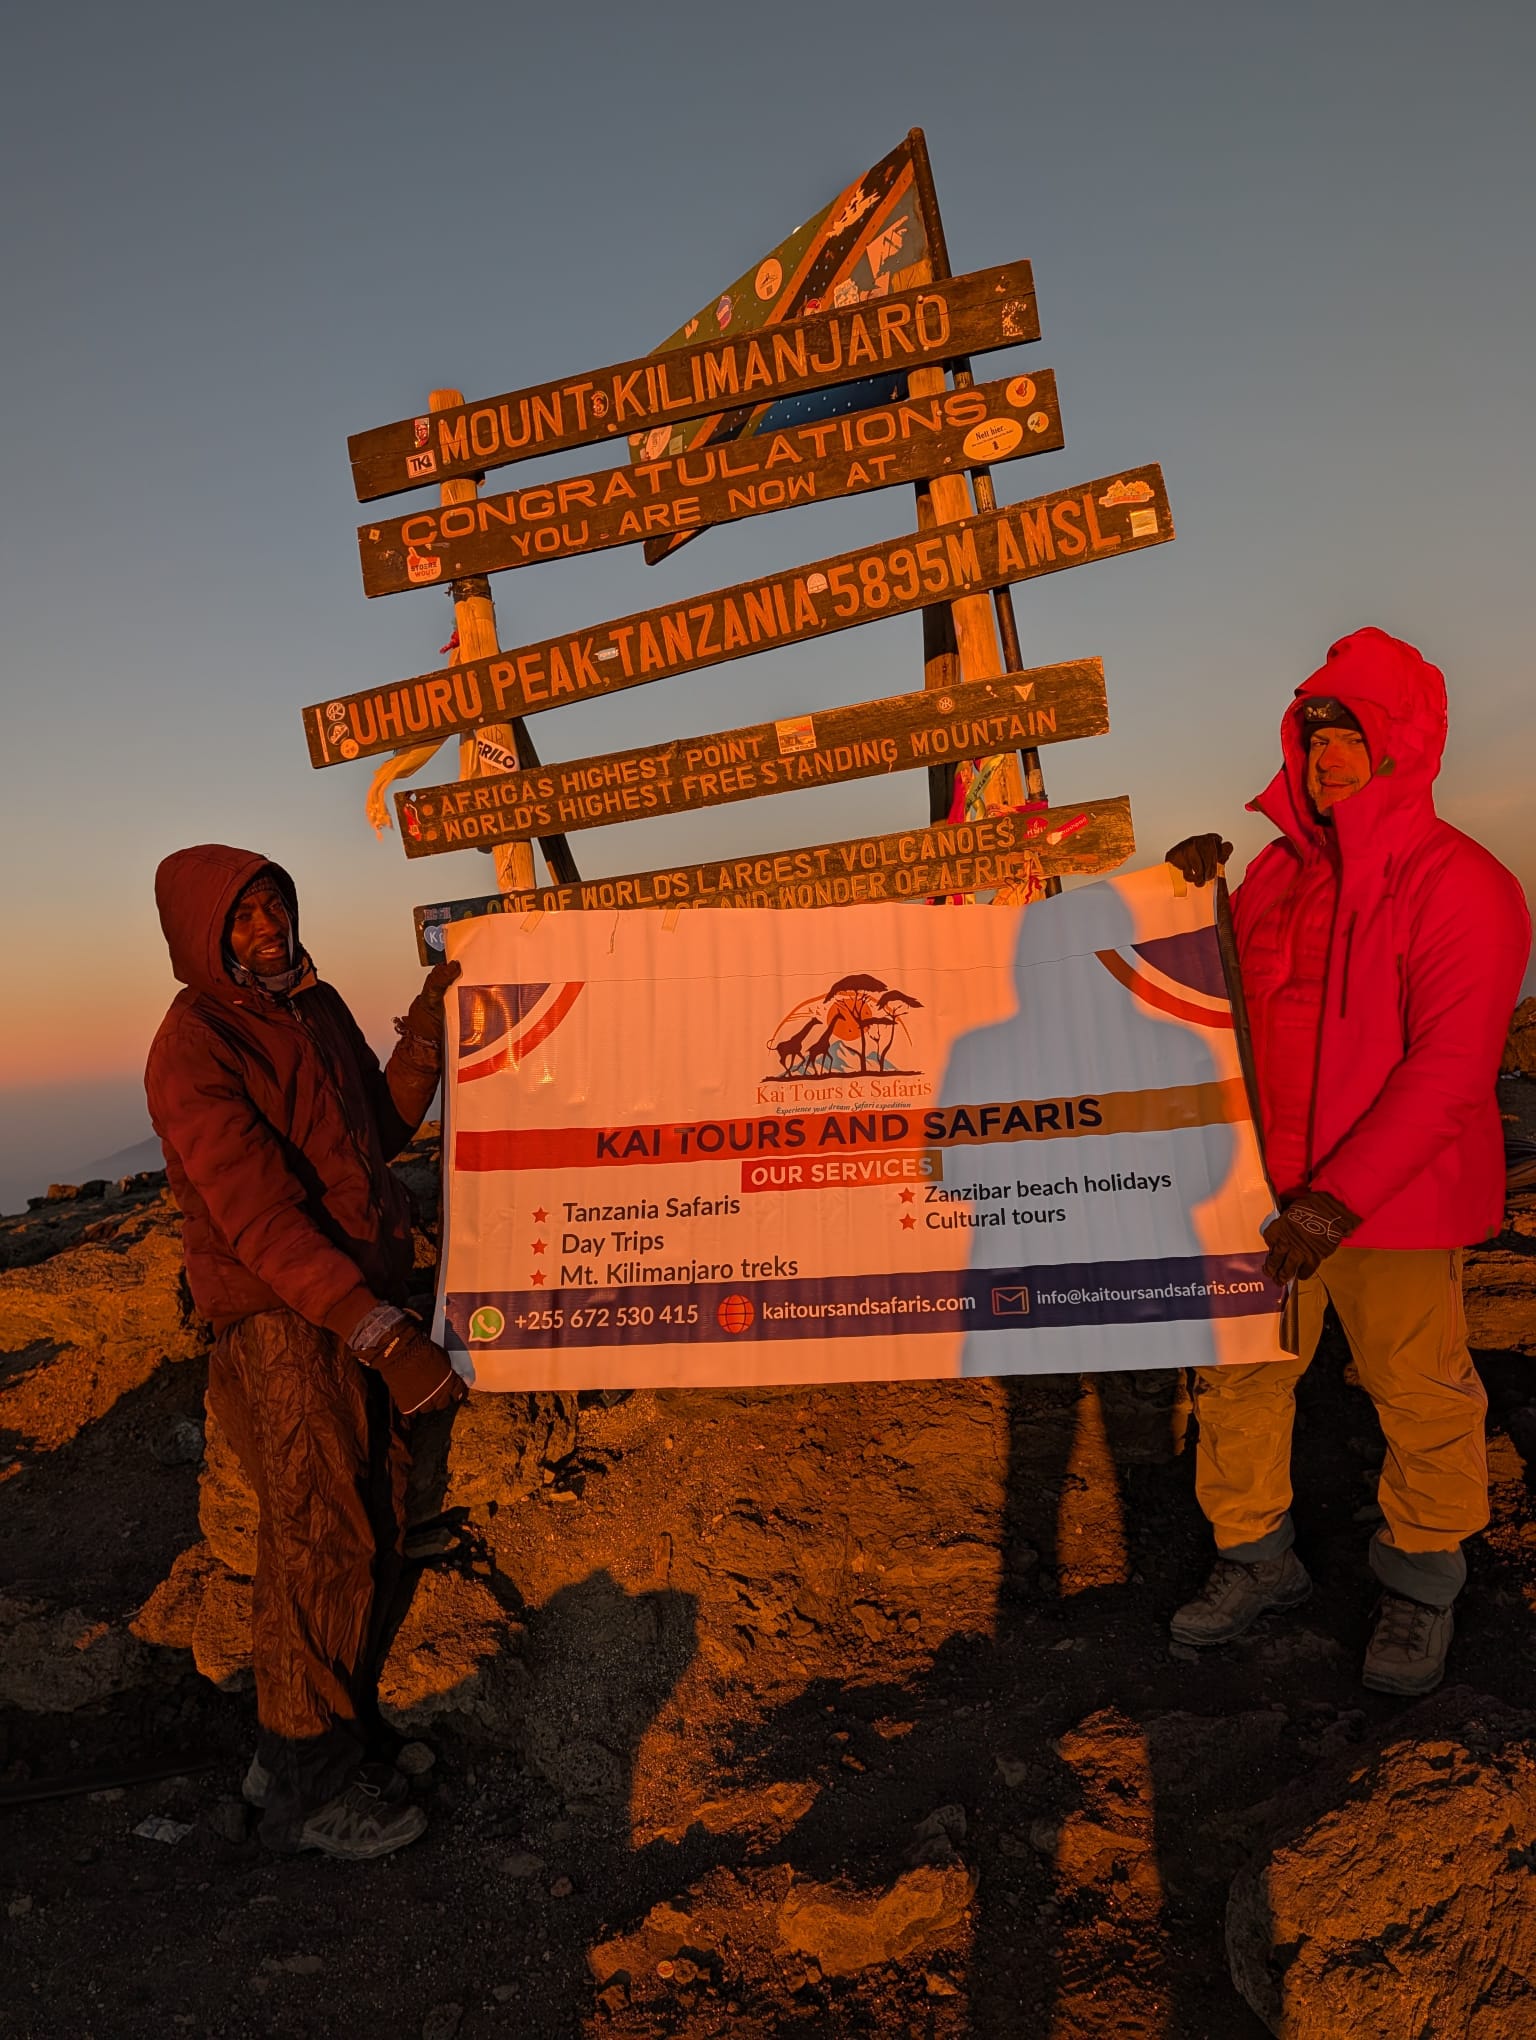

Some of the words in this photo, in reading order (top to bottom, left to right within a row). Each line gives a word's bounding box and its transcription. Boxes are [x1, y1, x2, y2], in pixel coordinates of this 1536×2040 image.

[439, 382, 594, 465] MOUNT
[612, 294, 949, 422] KILIMANJARO
[402, 392, 987, 546] CONGRATULATIONS
[511, 520, 589, 556] YOU
[618, 497, 700, 536] ARE
[728, 472, 816, 513] NOW
[847, 454, 897, 487] AT
[348, 670, 484, 745] UHURU
[827, 528, 982, 617] 5895M
[997, 493, 1121, 574] AMSL
[442, 804, 552, 842] WORLD'S
[559, 780, 673, 822] HIGHEST
[910, 707, 1057, 757] MOUNTAIN
[560, 753, 673, 794] HIGHEST
[685, 734, 766, 771] POINT
[543, 889, 573, 912] OF
[581, 872, 690, 910] WORLD'S
[696, 849, 830, 894] LARGEST
[840, 820, 1016, 872] VOLCANOES
[778, 871, 887, 910] WONDER
[895, 864, 929, 895] OF
[756, 1085, 785, 1104] Kai
[789, 1084, 844, 1102] Tours
[848, 1080, 868, 1099] &
[870, 1079, 932, 1098] Safaris
[776, 1106, 811, 1116] Experience
[812, 1105, 828, 1114] your
[828, 1103, 851, 1111] dream
[850, 1101, 875, 1112] Safari
[875, 1101, 912, 1110] expedition
[597, 1128, 661, 1159] KAI
[674, 1118, 806, 1155] TOURS
[818, 1113, 909, 1146] AND
[923, 1098, 1103, 1140] SAFARIS
[751, 1165, 803, 1186] OUR
[811, 1157, 933, 1183] SERVICES
[924, 1182, 1012, 1203] Zanzibar
[1016, 1176, 1079, 1198] beach
[1084, 1171, 1172, 1196] holidays
[562, 1199, 659, 1223] Tanzania
[665, 1194, 741, 1218] Safaris
[925, 1207, 1006, 1230] Cultural
[1012, 1207, 1067, 1225] tours
[562, 1233, 606, 1257] Day
[611, 1230, 665, 1255] Trips
[560, 1264, 599, 1286] Mt.
[607, 1259, 734, 1284] Kilimanjaro
[741, 1255, 799, 1278] treks
[762, 1293, 977, 1320] kaitoursandsafaris.com
[1036, 1280, 1265, 1305] info@kaitoursandsafaris.com
[514, 1309, 564, 1330] +255
[570, 1307, 609, 1328] 672
[616, 1306, 655, 1327] 530
[659, 1304, 699, 1324] 415
